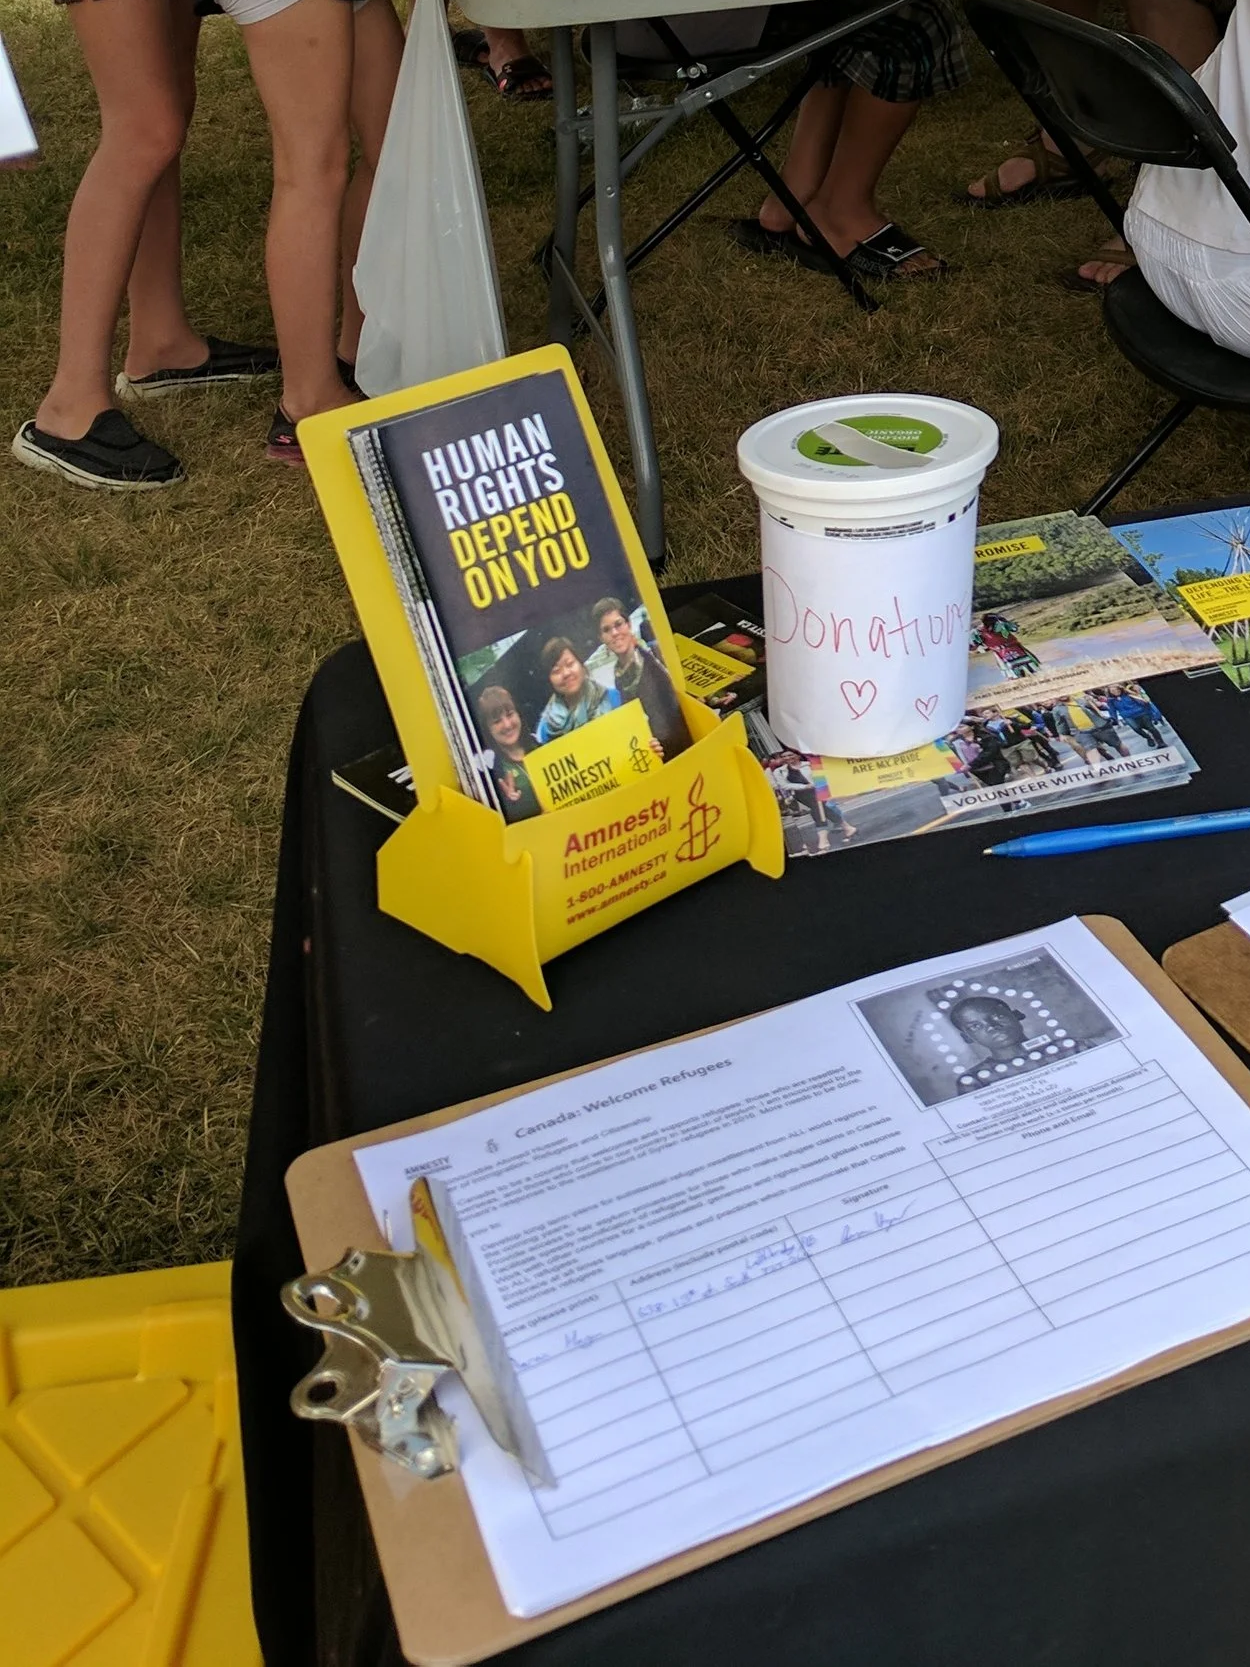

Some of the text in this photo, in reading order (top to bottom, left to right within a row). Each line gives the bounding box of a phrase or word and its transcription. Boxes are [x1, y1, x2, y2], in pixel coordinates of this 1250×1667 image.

[421, 413, 552, 490] HUMAN
[435, 452, 565, 531] RIGHTS
[449, 492, 577, 570] DEPEND
[974, 542, 1029, 559] ROMISE
[464, 526, 591, 609] ON YOU
[1186, 577, 1242, 595] DEFENDING
[1191, 591, 1212, 601] LIFE
[1224, 584, 1242, 594] THE
[684, 672, 715, 689] JOIN
[542, 753, 580, 787] JOIN
[550, 756, 614, 805] AMNESTY
[852, 760, 874, 775] ARE
[876, 756, 895, 770] MY
[895, 752, 921, 767] PRIDE
[952, 752, 1172, 808] VOLUNTEER WITH AMNESTY
[564, 796, 670, 858] Amnesty
[564, 817, 672, 879] International
[566, 851, 669, 909] 1-800-AMNESTY
[566, 870, 667, 925] www.amnesty.ca
[513, 1055, 733, 1138] Canada: Welcome Refugees
[1021, 1108, 1096, 1139] Phone and Email
[404, 1155, 450, 1175] AMNESTY
[841, 1183, 889, 1206] Signature
